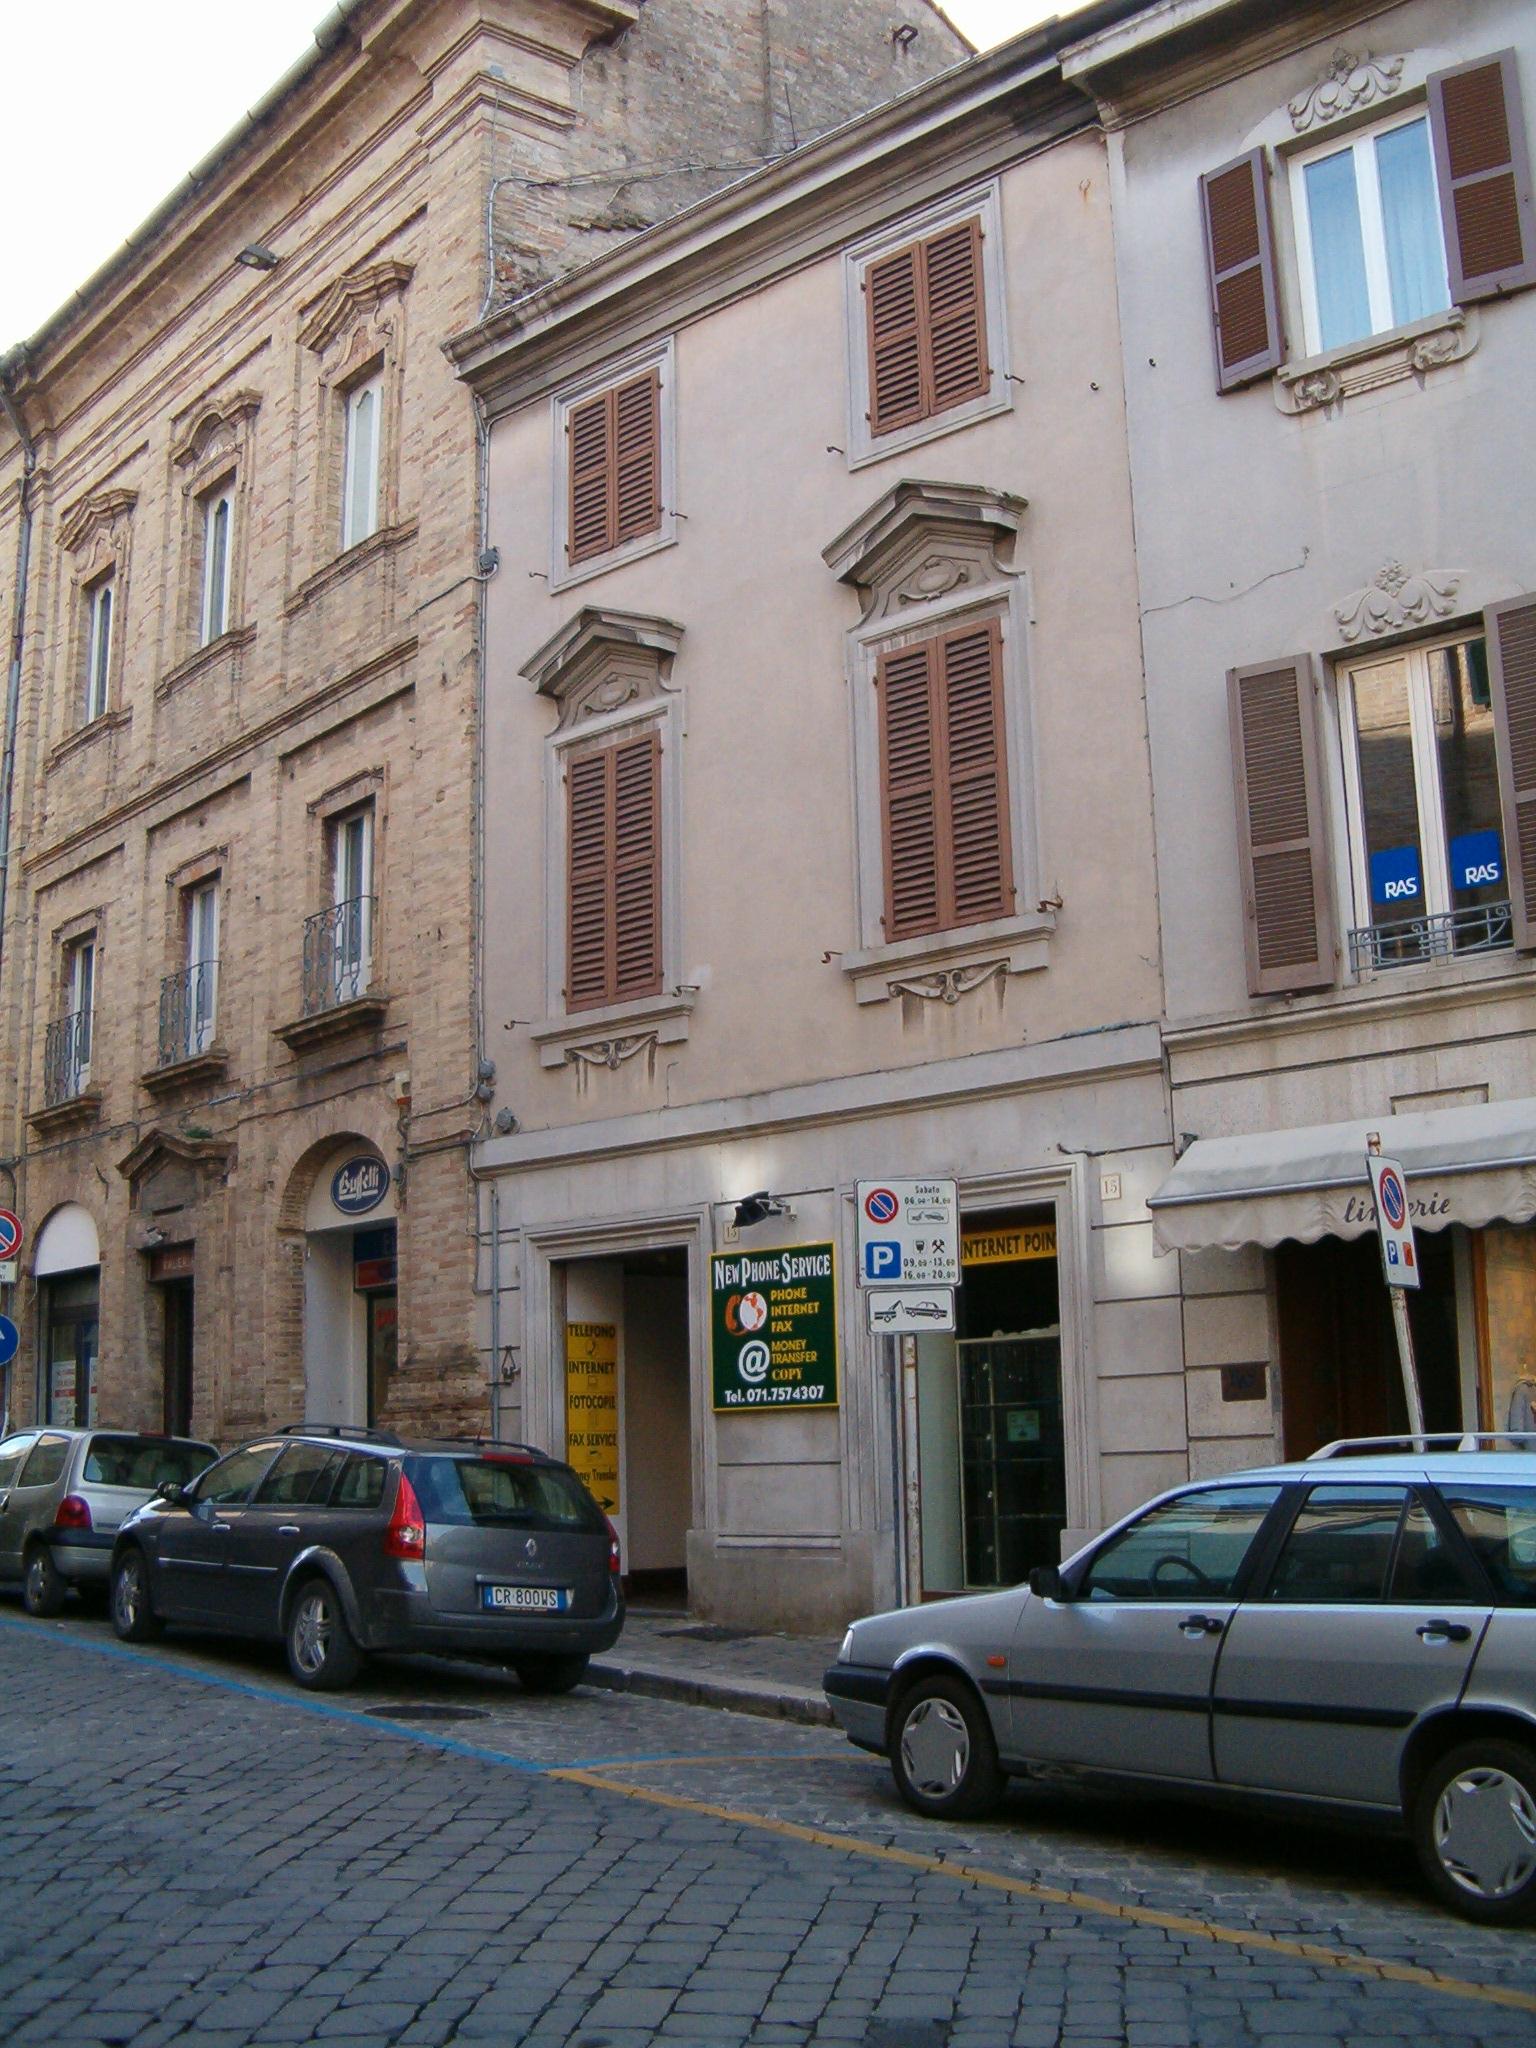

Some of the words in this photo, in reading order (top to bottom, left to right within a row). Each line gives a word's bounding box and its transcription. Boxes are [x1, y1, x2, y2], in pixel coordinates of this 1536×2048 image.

[1464, 862, 1499, 884] RAS
[1384, 876, 1418, 899] RAS
[1344, 1192, 1451, 1223] linerie
[961, 1234, 1021, 1259] INTERNET
[1024, 1231, 1057, 1252] POIN
[741, 1257, 780, 1287] PHONE
[781, 1252, 831, 1284] SERVICE
[770, 1287, 808, 1300] PHONE
[771, 1302, 820, 1316] INTERNET
[568, 1324, 616, 1338] TELEFONO
[771, 1321, 793, 1333] FAX
[771, 1339, 807, 1350] MONEY
[771, 1351, 818, 1364] TRANSFER
[568, 1361, 616, 1375] INTERNET
[772, 1368, 803, 1381] COPY
[724, 1389, 745, 1403] Tel.
[746, 1385, 825, 1402] 071.7574307
[569, 1433, 585, 1446] FAX
[586, 1432, 617, 1446] SERVICE
[494, 1588, 512, 1605] CR
[517, 1589, 557, 1606] 800WS
